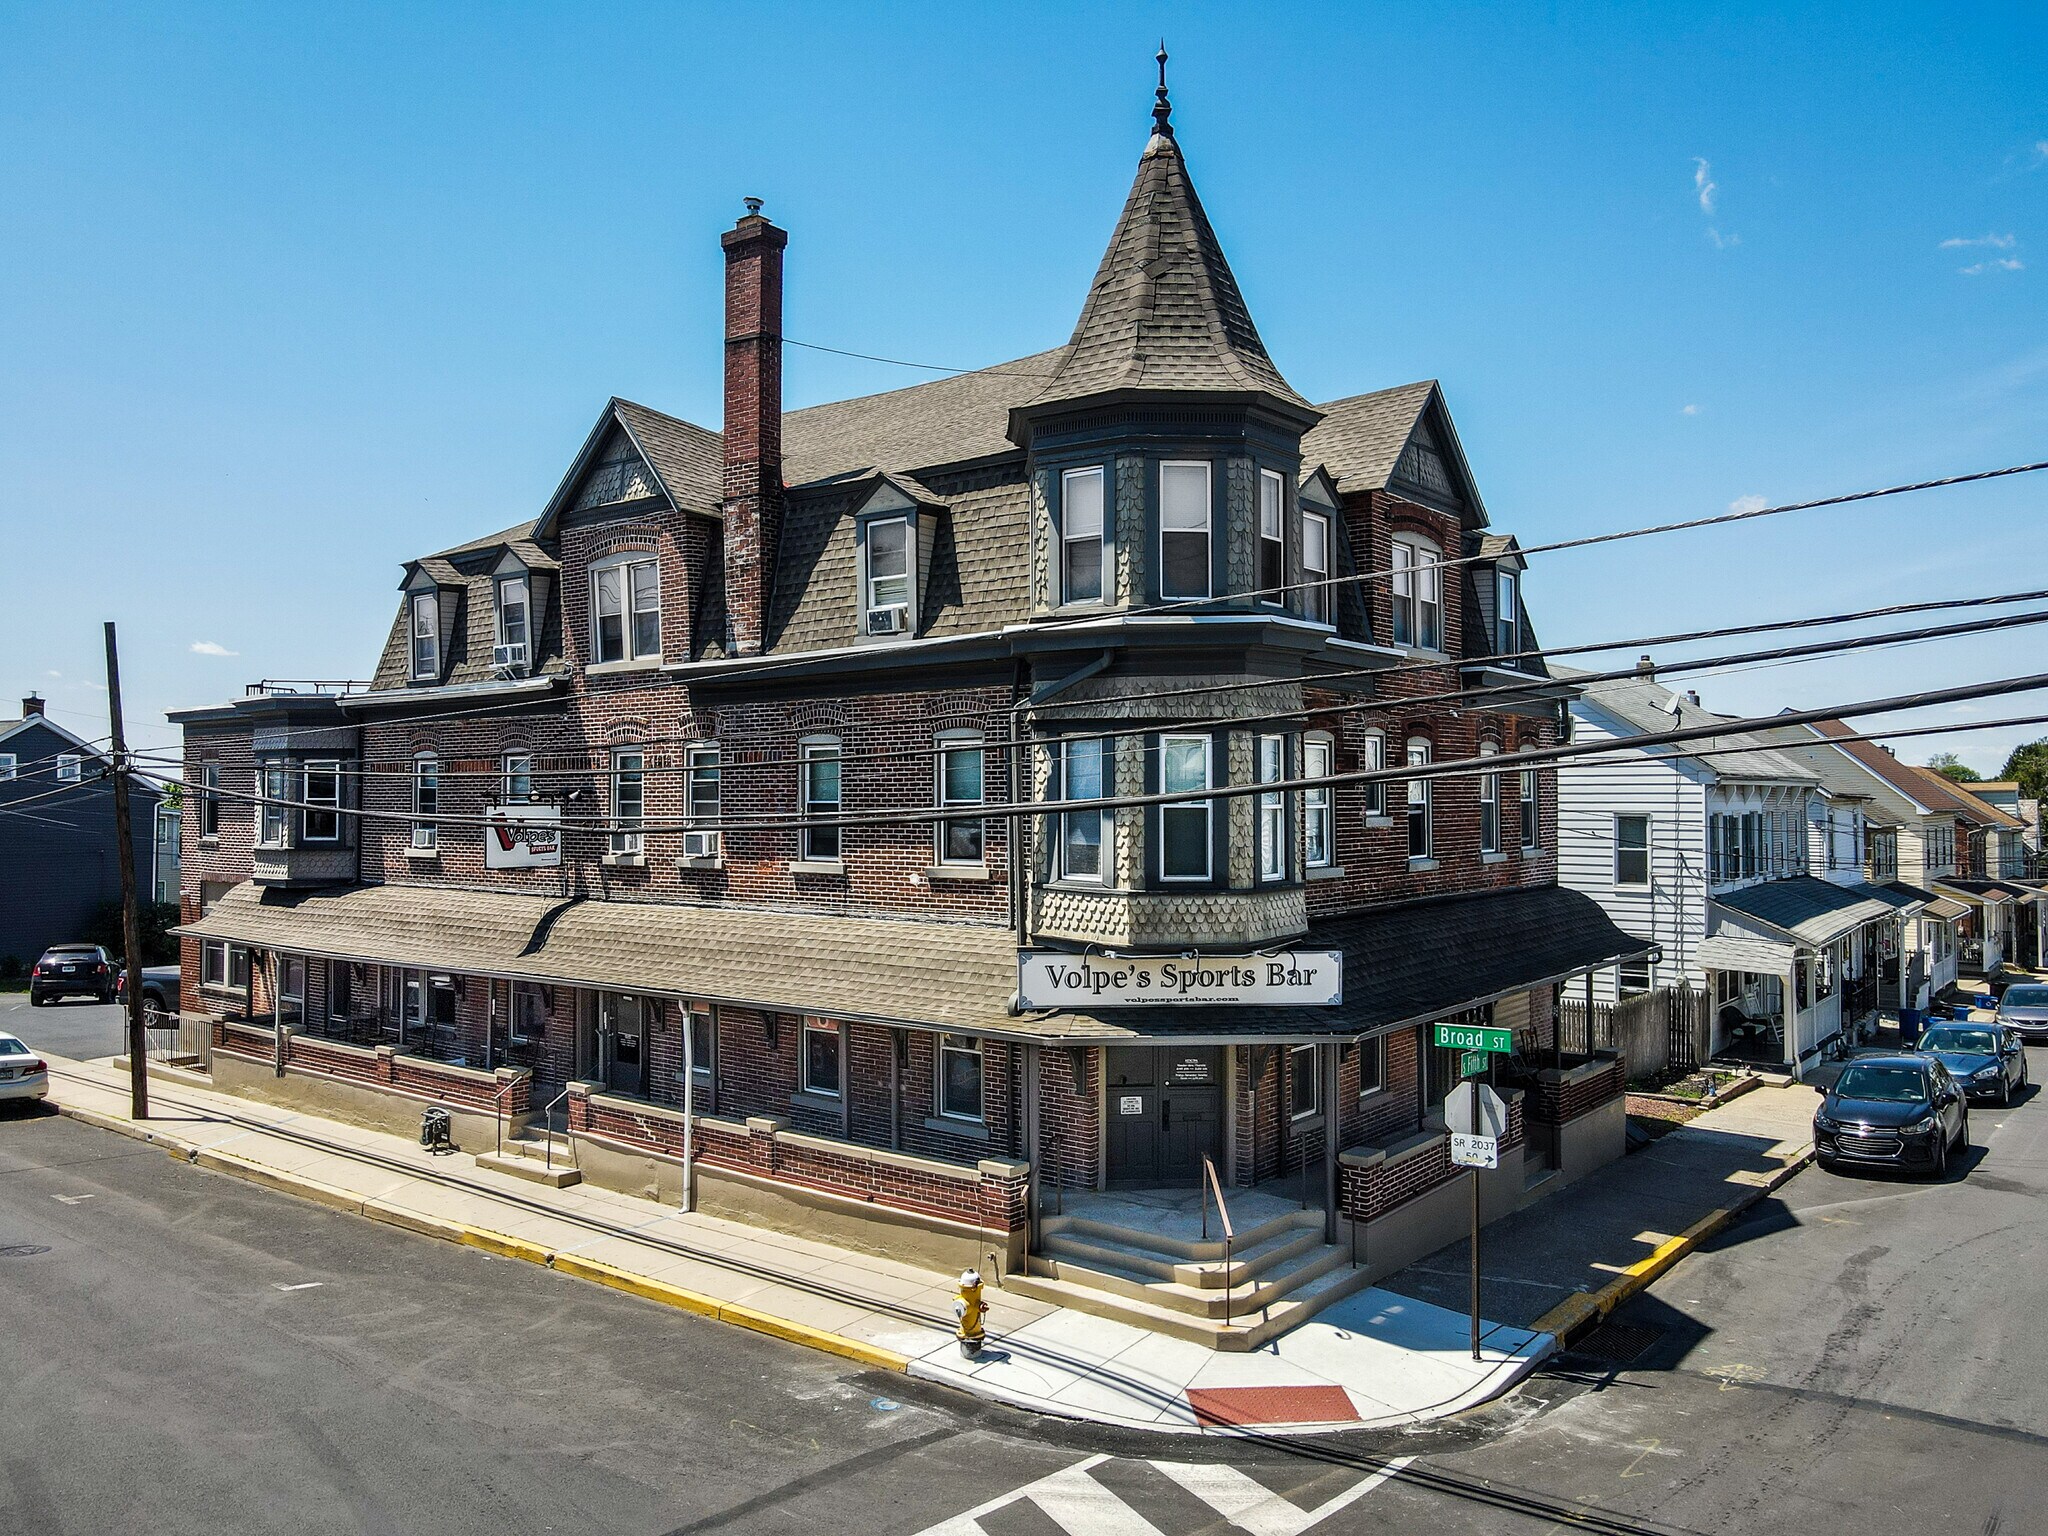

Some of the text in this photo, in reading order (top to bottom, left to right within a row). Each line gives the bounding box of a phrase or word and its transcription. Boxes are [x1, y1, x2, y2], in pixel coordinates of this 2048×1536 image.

[1045, 963, 1318, 994] Volpe's Sports Bar
[1440, 1027, 1505, 1049] Broad ST
[1467, 1055, 1480, 1073] Fifth
[1453, 1137, 1495, 1151] SR 2037
